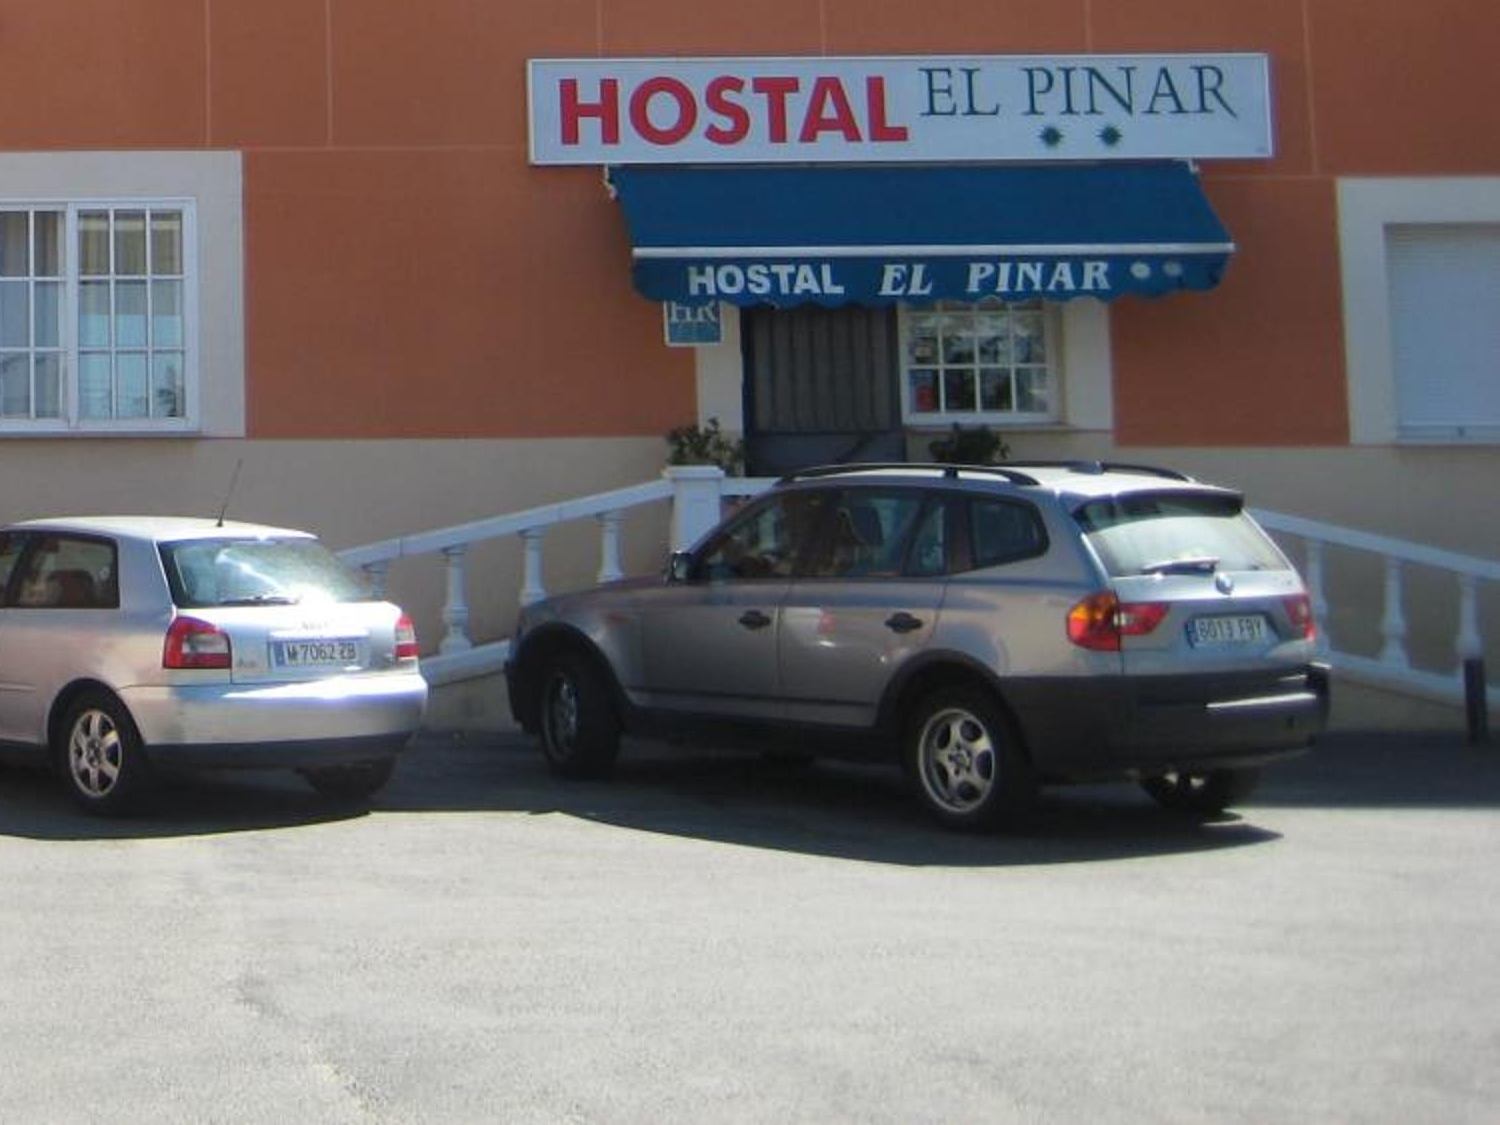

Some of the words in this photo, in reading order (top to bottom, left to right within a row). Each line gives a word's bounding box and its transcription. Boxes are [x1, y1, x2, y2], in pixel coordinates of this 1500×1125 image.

[558, 76, 909, 145] HOSTAL
[918, 67, 1000, 117] EL
[1022, 65, 1238, 119] PINAR
[688, 264, 845, 297] HOSTAL
[877, 264, 933, 296] EL
[964, 261, 1111, 293] PINAR
